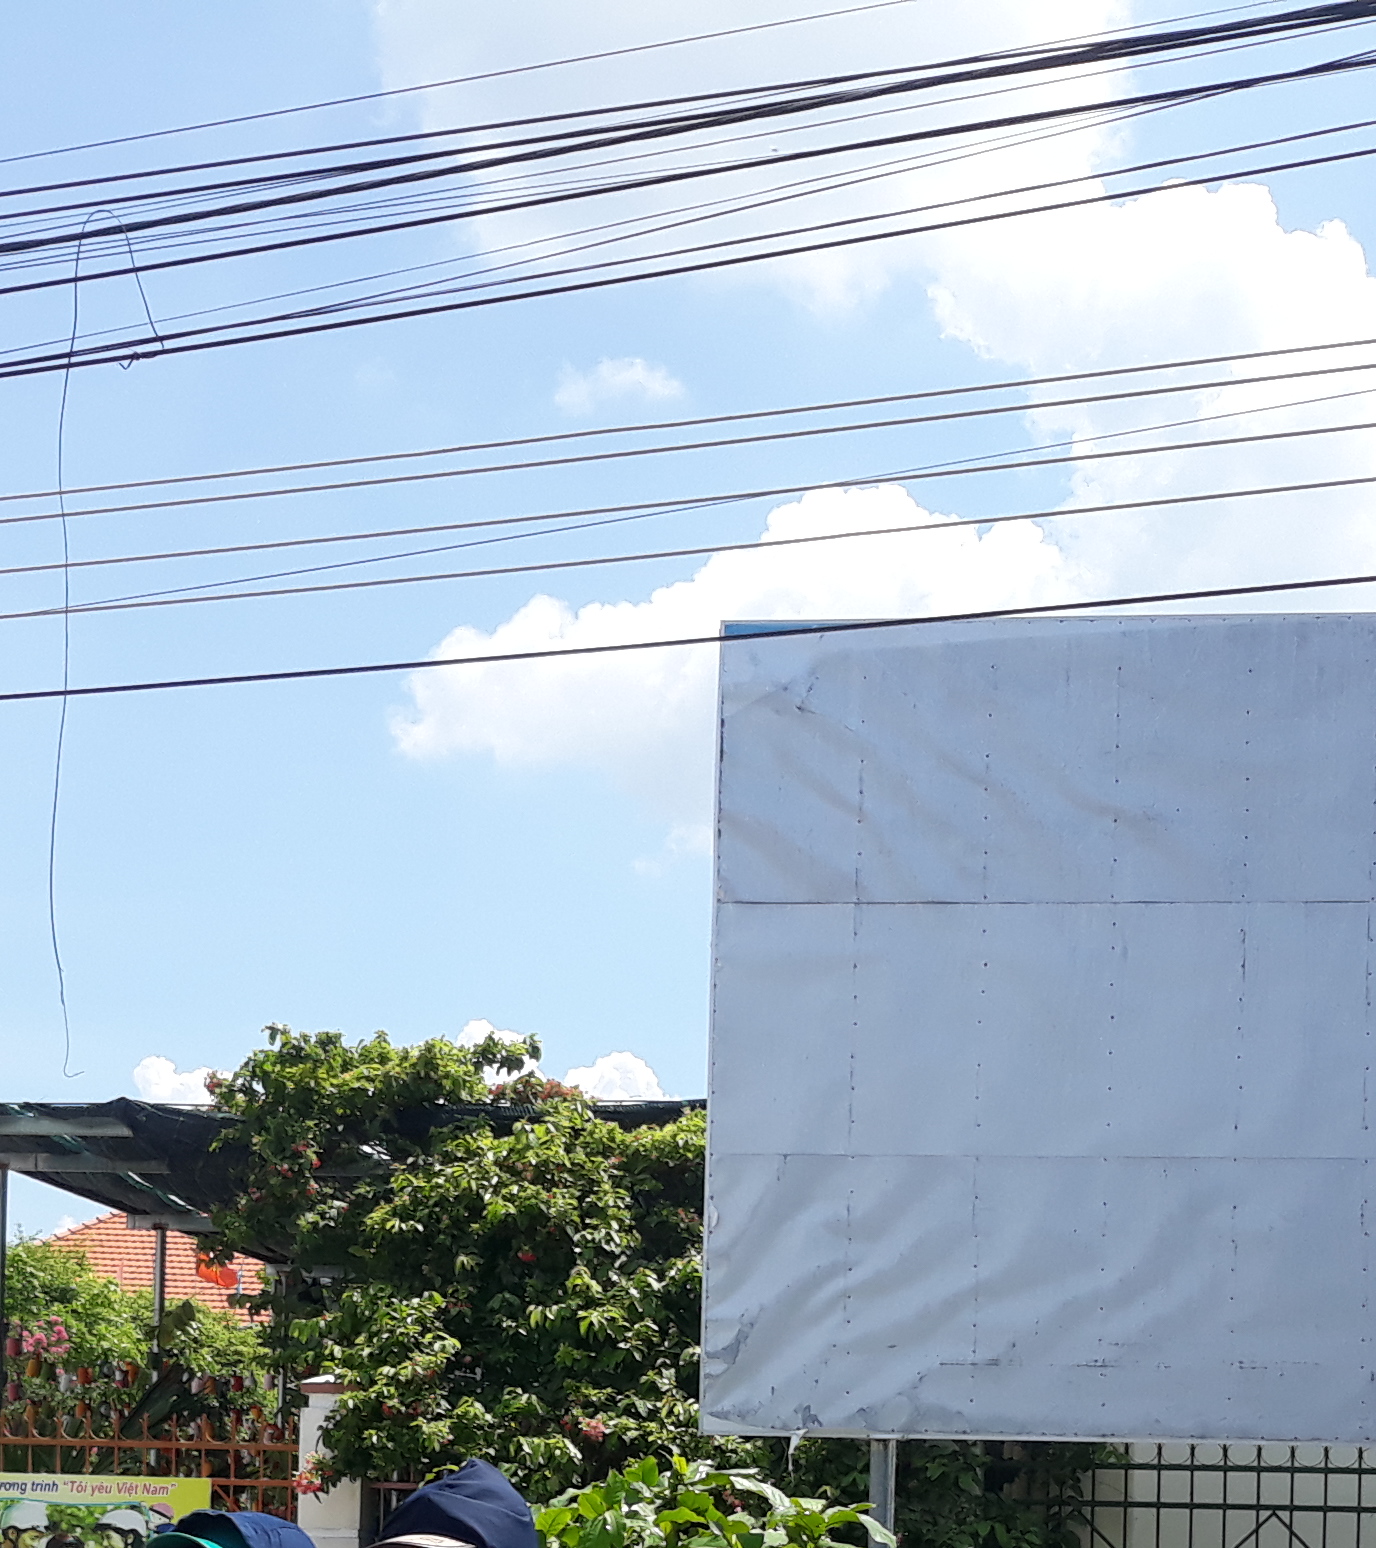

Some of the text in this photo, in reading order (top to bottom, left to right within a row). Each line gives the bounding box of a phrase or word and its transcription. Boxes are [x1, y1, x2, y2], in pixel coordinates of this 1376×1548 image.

[31, 1479, 59, 1493] trình
[91, 1482, 112, 1497] yêu
[116, 1481, 139, 1497] Việt
